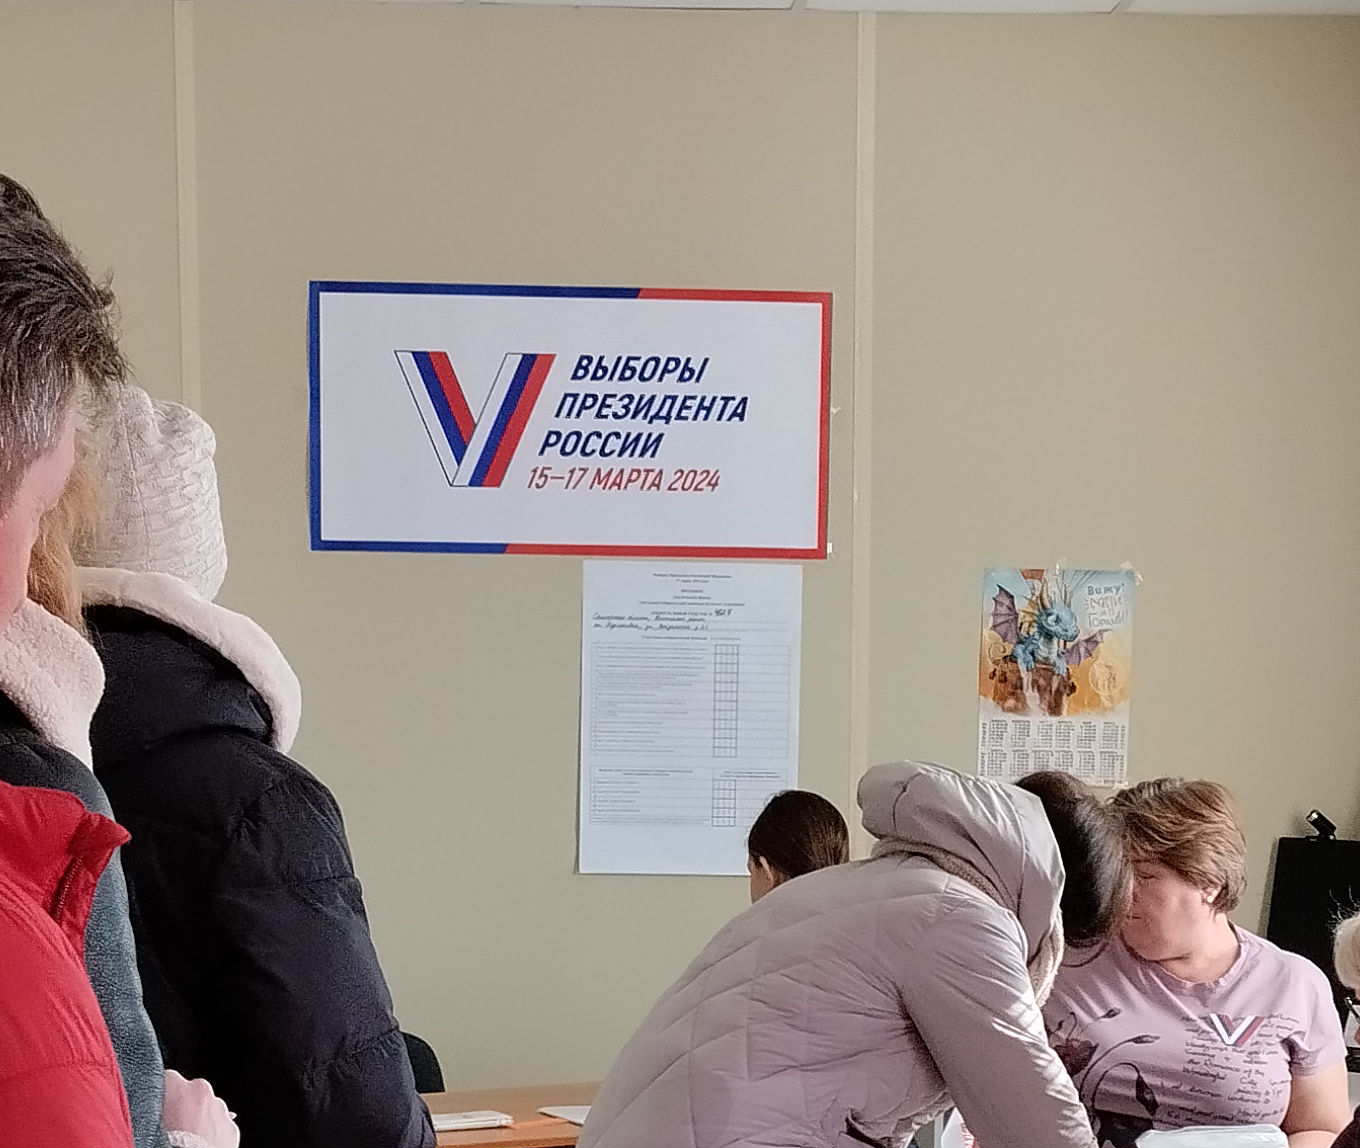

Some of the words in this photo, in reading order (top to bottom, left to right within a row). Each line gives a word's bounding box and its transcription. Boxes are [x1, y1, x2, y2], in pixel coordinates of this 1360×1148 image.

[570, 355, 710, 383] ВЫБОРЫ
[554, 393, 749, 425] ПРЕЗИДЕНТА
[539, 430, 665, 459] РОССИИ
[589, 468, 664, 491] МАРТА
[667, 469, 720, 492] 2024
